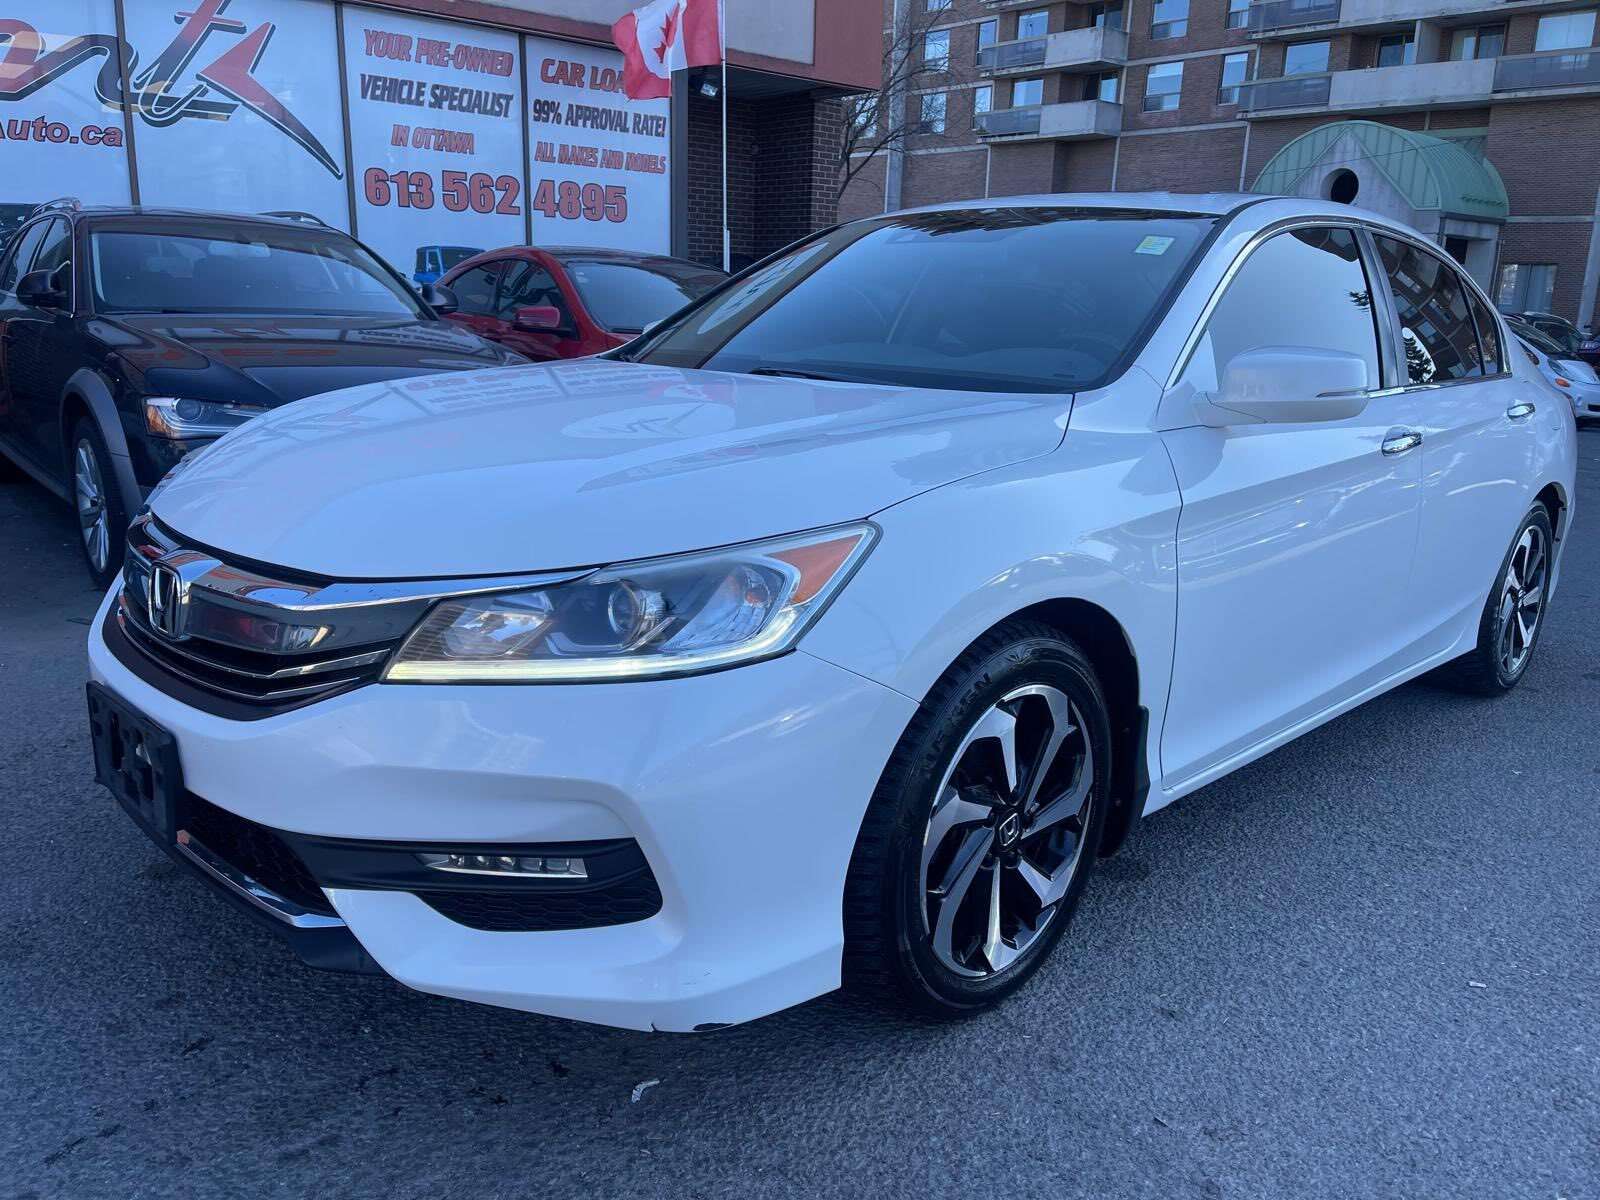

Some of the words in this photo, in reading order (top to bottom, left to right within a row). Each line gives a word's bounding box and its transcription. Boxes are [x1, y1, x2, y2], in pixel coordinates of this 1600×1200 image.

[364, 29, 413, 62] YOUR
[414, 37, 514, 77] PRE-OWNED
[360, 73, 426, 106] VEHICLE
[428, 83, 514, 118] SPECIALIST
[541, 58, 585, 88] CAR
[589, 65, 626, 94] LOA
[533, 98, 562, 125] 99%
[565, 103, 630, 133] APPROVAL
[632, 112, 667, 137] RATE!
[391, 124, 410, 147] IN
[412, 126, 474, 155] OTTAWA
[534, 141, 556, 162] ALL
[558, 143, 599, 168] MAKES
[600, 149, 624, 169] AND
[625, 152, 666, 175] MODELS
[364, 167, 434, 210] 613
[442, 170, 521, 216] 562
[533, 179, 628, 223] 4895
